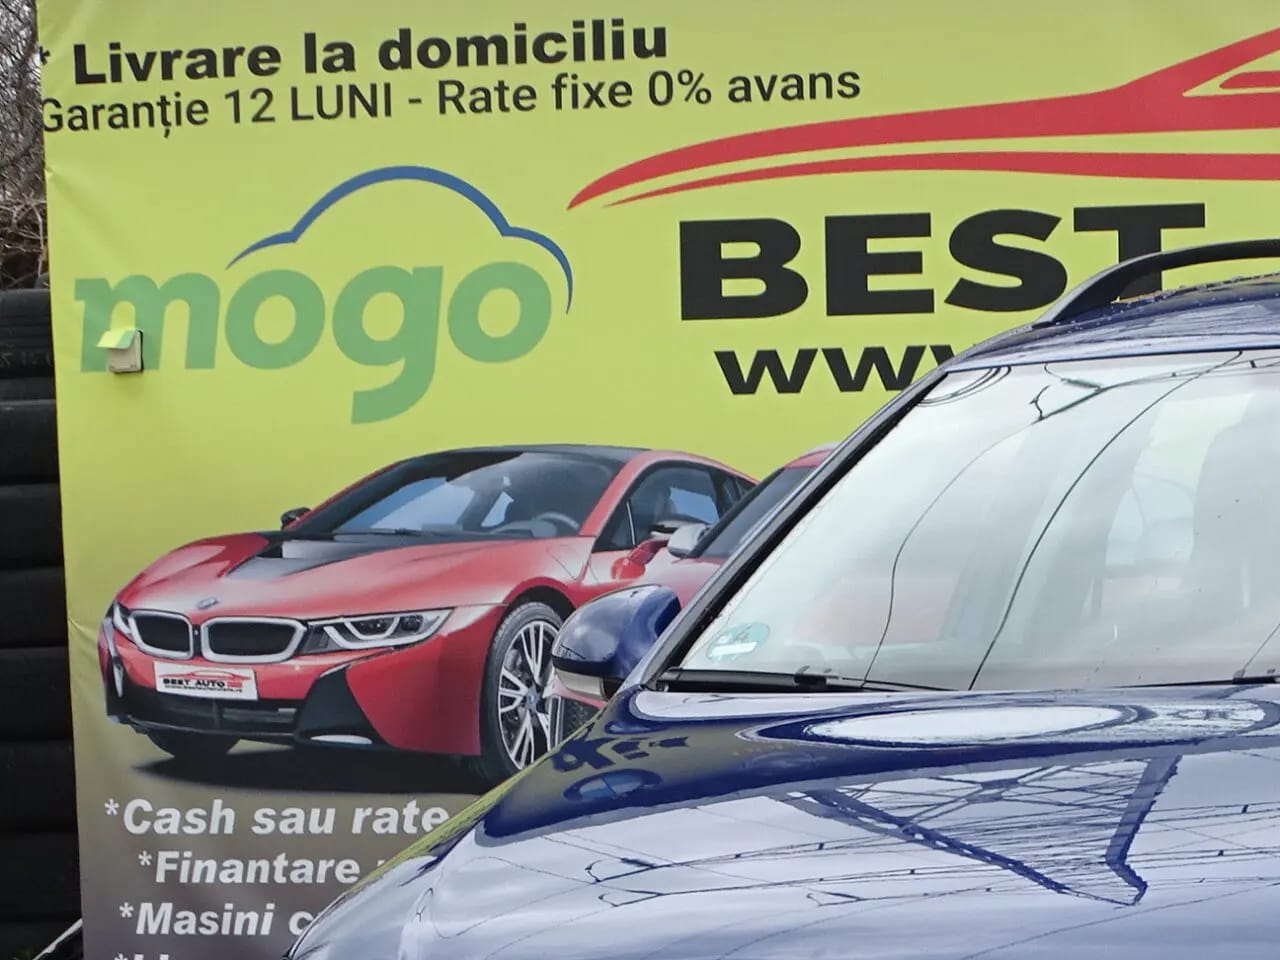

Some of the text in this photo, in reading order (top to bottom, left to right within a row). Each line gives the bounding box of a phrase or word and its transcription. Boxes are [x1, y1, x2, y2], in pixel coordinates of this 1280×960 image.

[73, 18, 668, 84] Livrare la domiciliu
[41, 91, 209, 138] Garanție
[225, 87, 276, 123] 12
[290, 82, 392, 121] LUNI
[438, 78, 537, 115] Rate
[552, 72, 633, 110] fixe
[648, 68, 712, 106] 0%
[727, 70, 860, 103] avans
[679, 203, 1206, 320] BEST
[74, 261, 553, 424] mogo
[713, 344, 952, 395] ww
[252, 806, 336, 835] sau
[351, 799, 450, 835] rate
